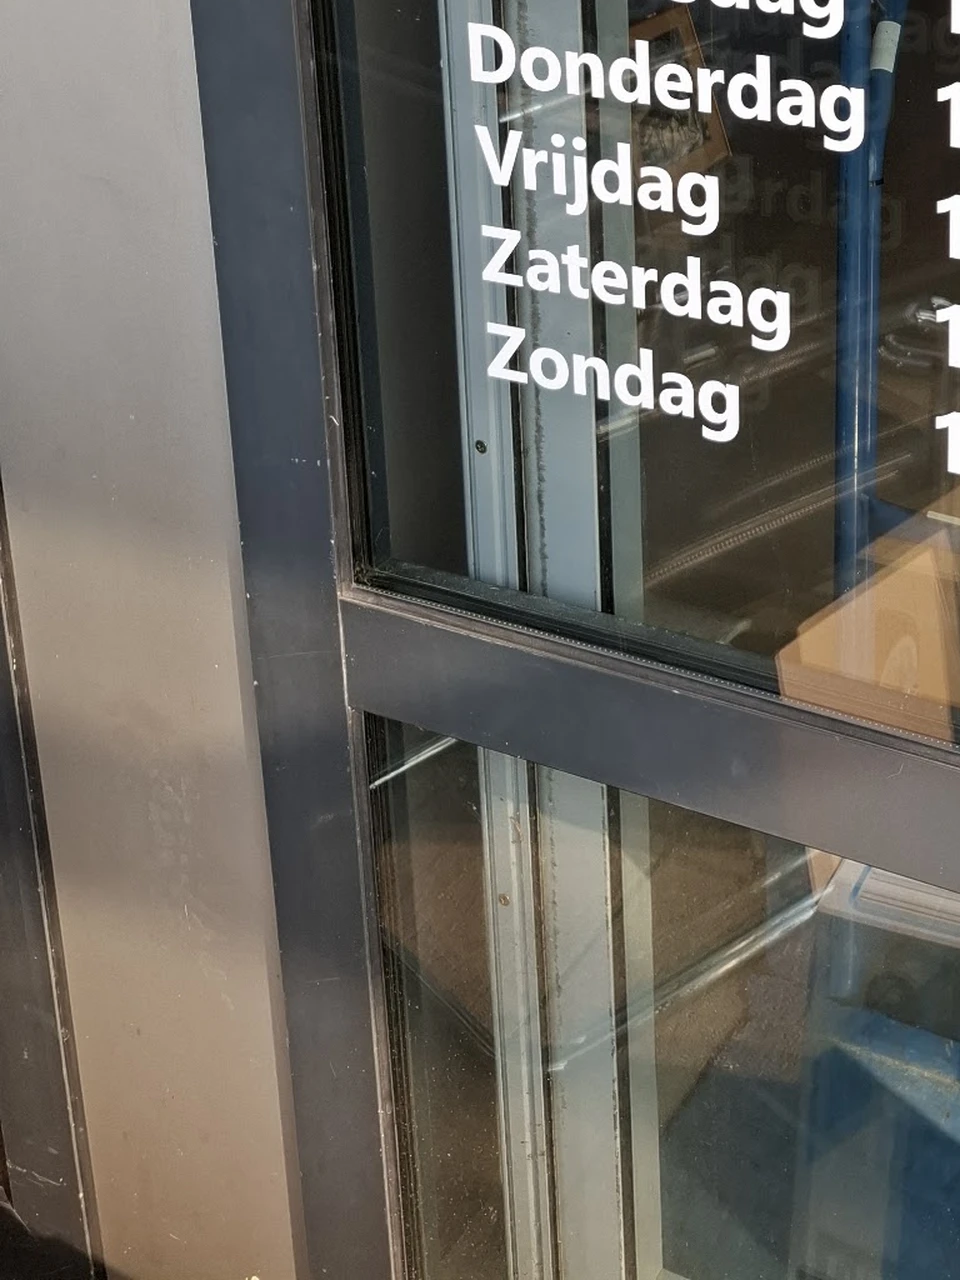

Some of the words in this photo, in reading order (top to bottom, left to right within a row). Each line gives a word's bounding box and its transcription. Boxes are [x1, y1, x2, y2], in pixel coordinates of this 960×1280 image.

[468, 23, 864, 151] Donderdag
[475, 125, 718, 235] Vrijdag
[482, 225, 790, 350] Zaterdag
[487, 322, 739, 441] Zondag
